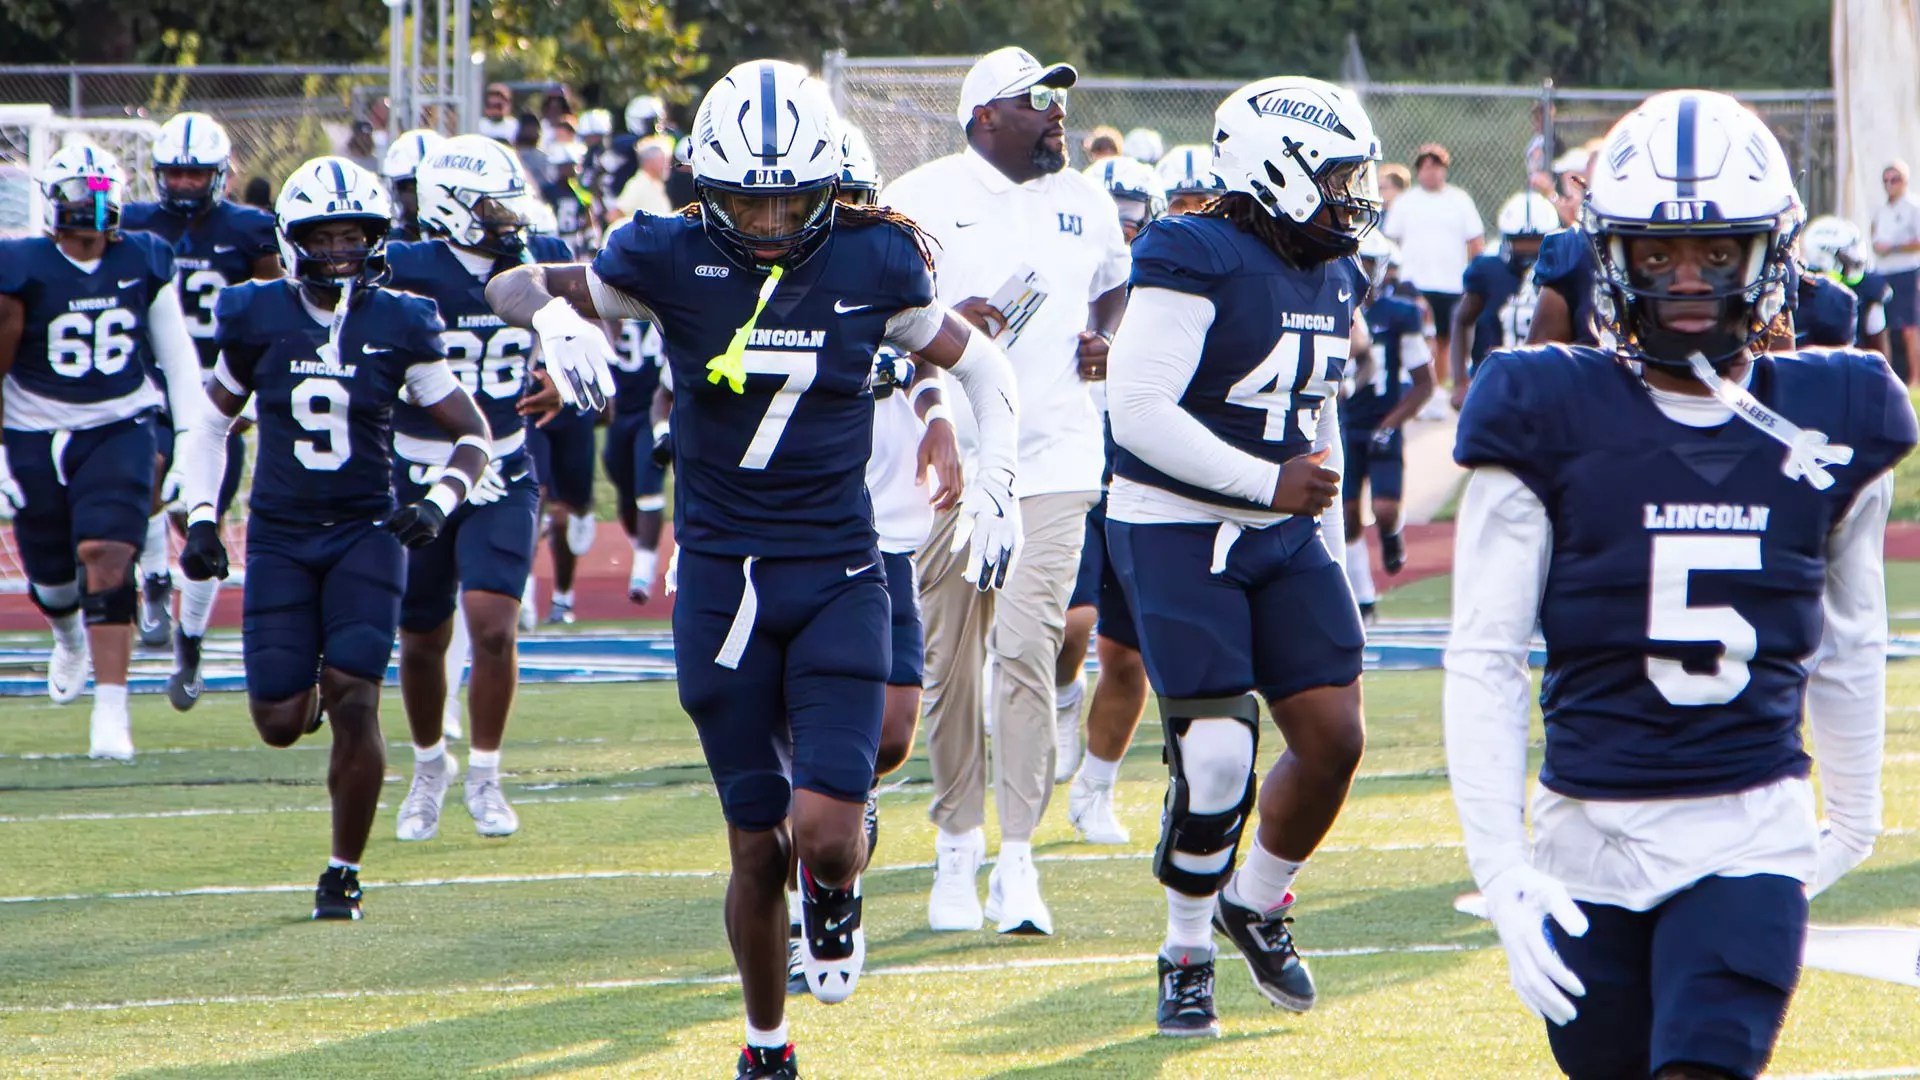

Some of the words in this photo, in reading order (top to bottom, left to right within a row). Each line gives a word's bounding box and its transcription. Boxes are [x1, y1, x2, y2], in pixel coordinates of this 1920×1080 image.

[1262, 96, 1339, 130] LINCOLN
[755, 169, 784, 184] DAT
[1056, 212, 1083, 236] LU
[1664, 202, 1707, 220] DAT
[695, 266, 729, 278] GLVC
[1281, 311, 1335, 332] LINCOLN
[48, 308, 136, 378] 66
[735, 328, 826, 347] INCOLN
[1225, 332, 1350, 441] 45
[738, 350, 817, 469] 7
[291, 378, 351, 470] 9
[1643, 504, 1770, 531] LINCOLN
[1647, 536, 1763, 706] 5
